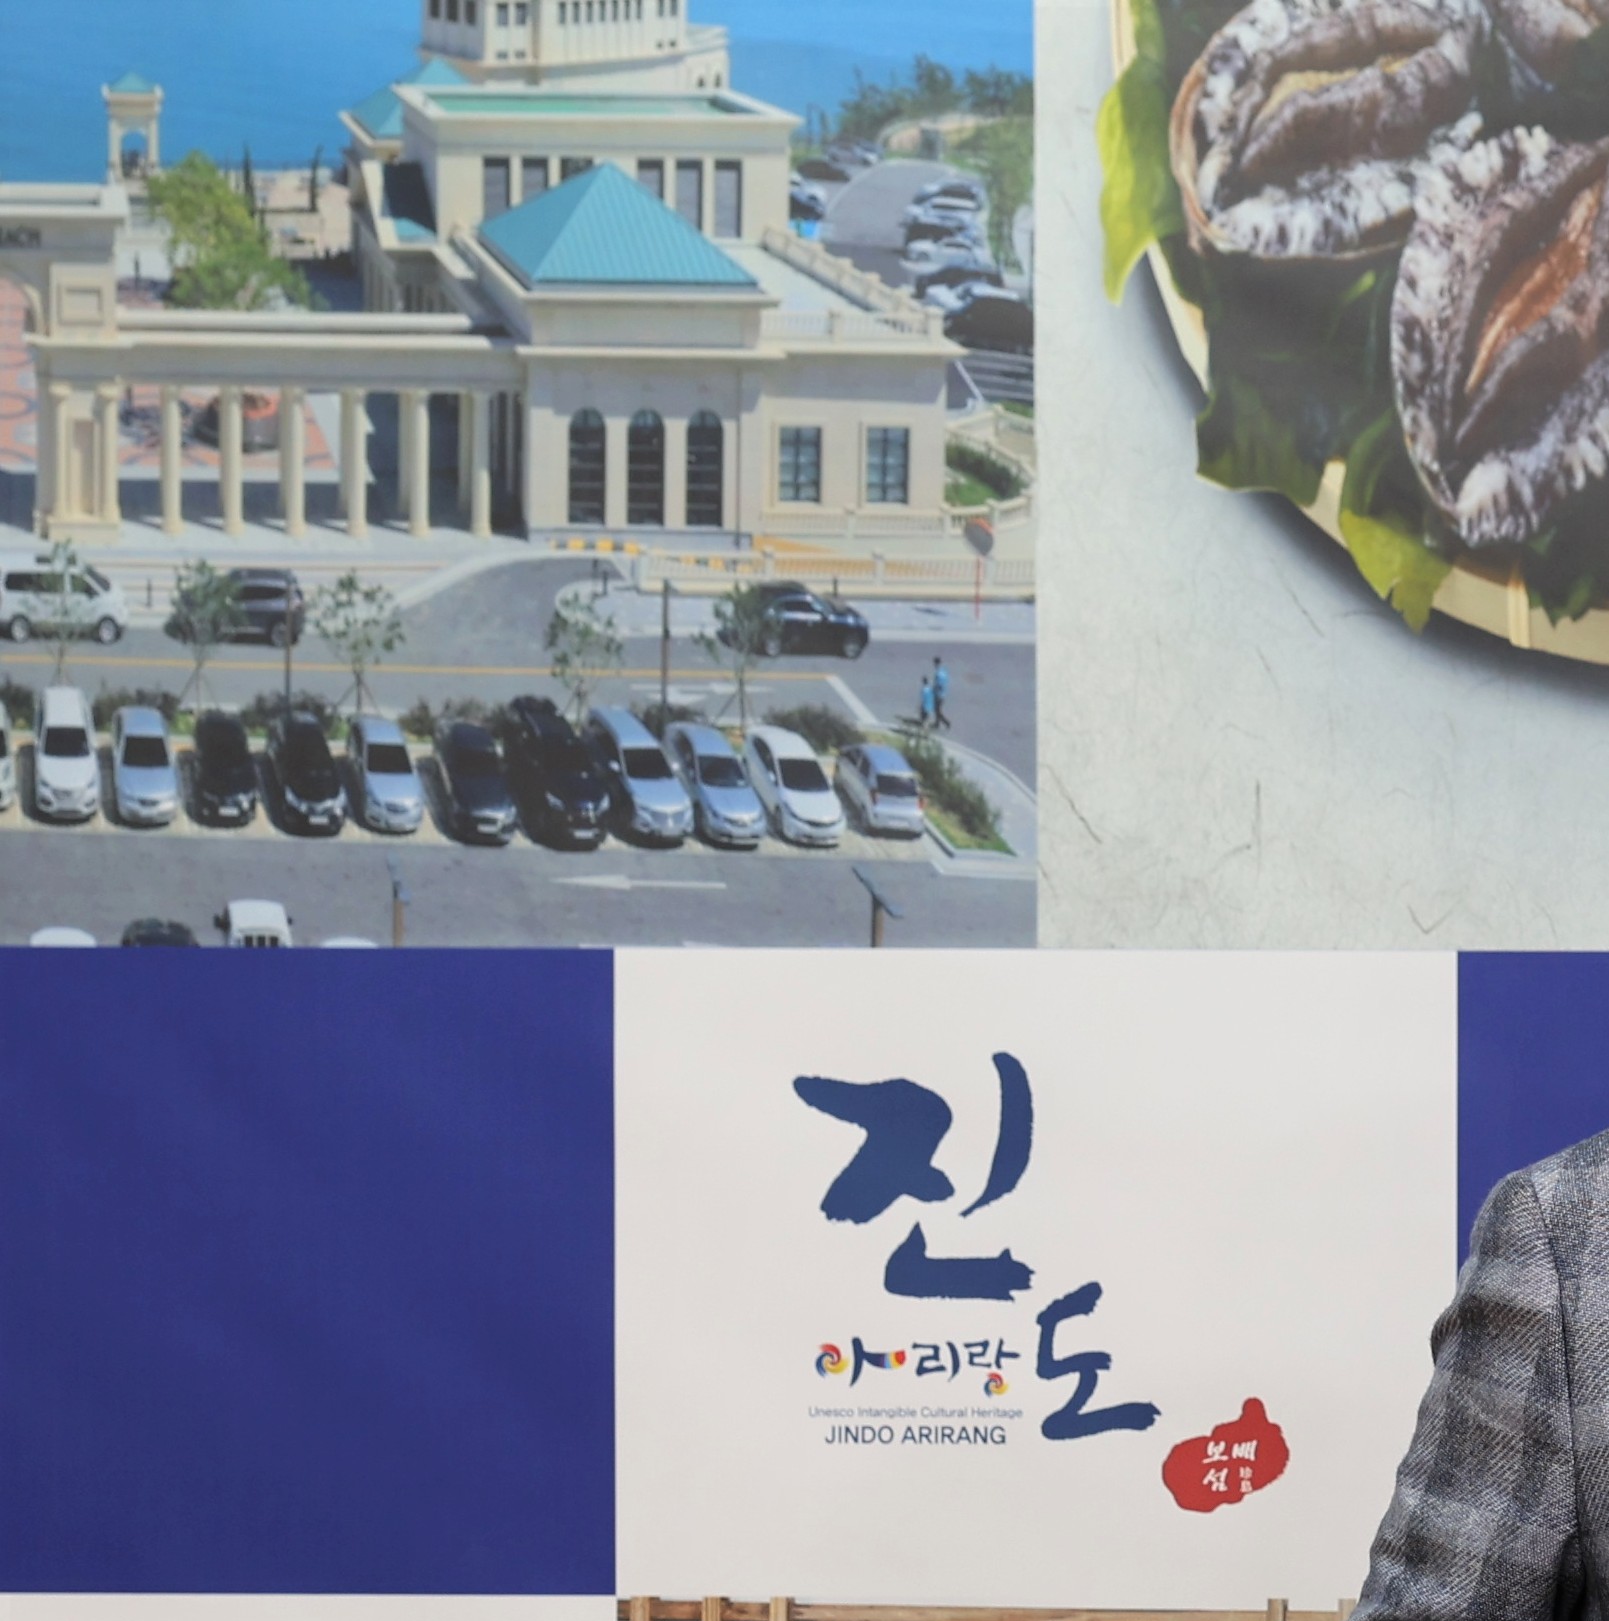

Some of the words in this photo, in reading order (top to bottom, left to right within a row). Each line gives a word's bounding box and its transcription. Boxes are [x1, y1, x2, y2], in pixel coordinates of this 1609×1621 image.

[815, 1337, 1020, 1397] 아리랑
[809, 1406, 854, 1418] Unesco
[857, 1405, 917, 1420] Intangible
[920, 1406, 967, 1418] Cultural
[971, 1406, 1024, 1420] Heritage
[825, 1426, 895, 1444] JINDO
[901, 1426, 1007, 1444] ARIRANG
